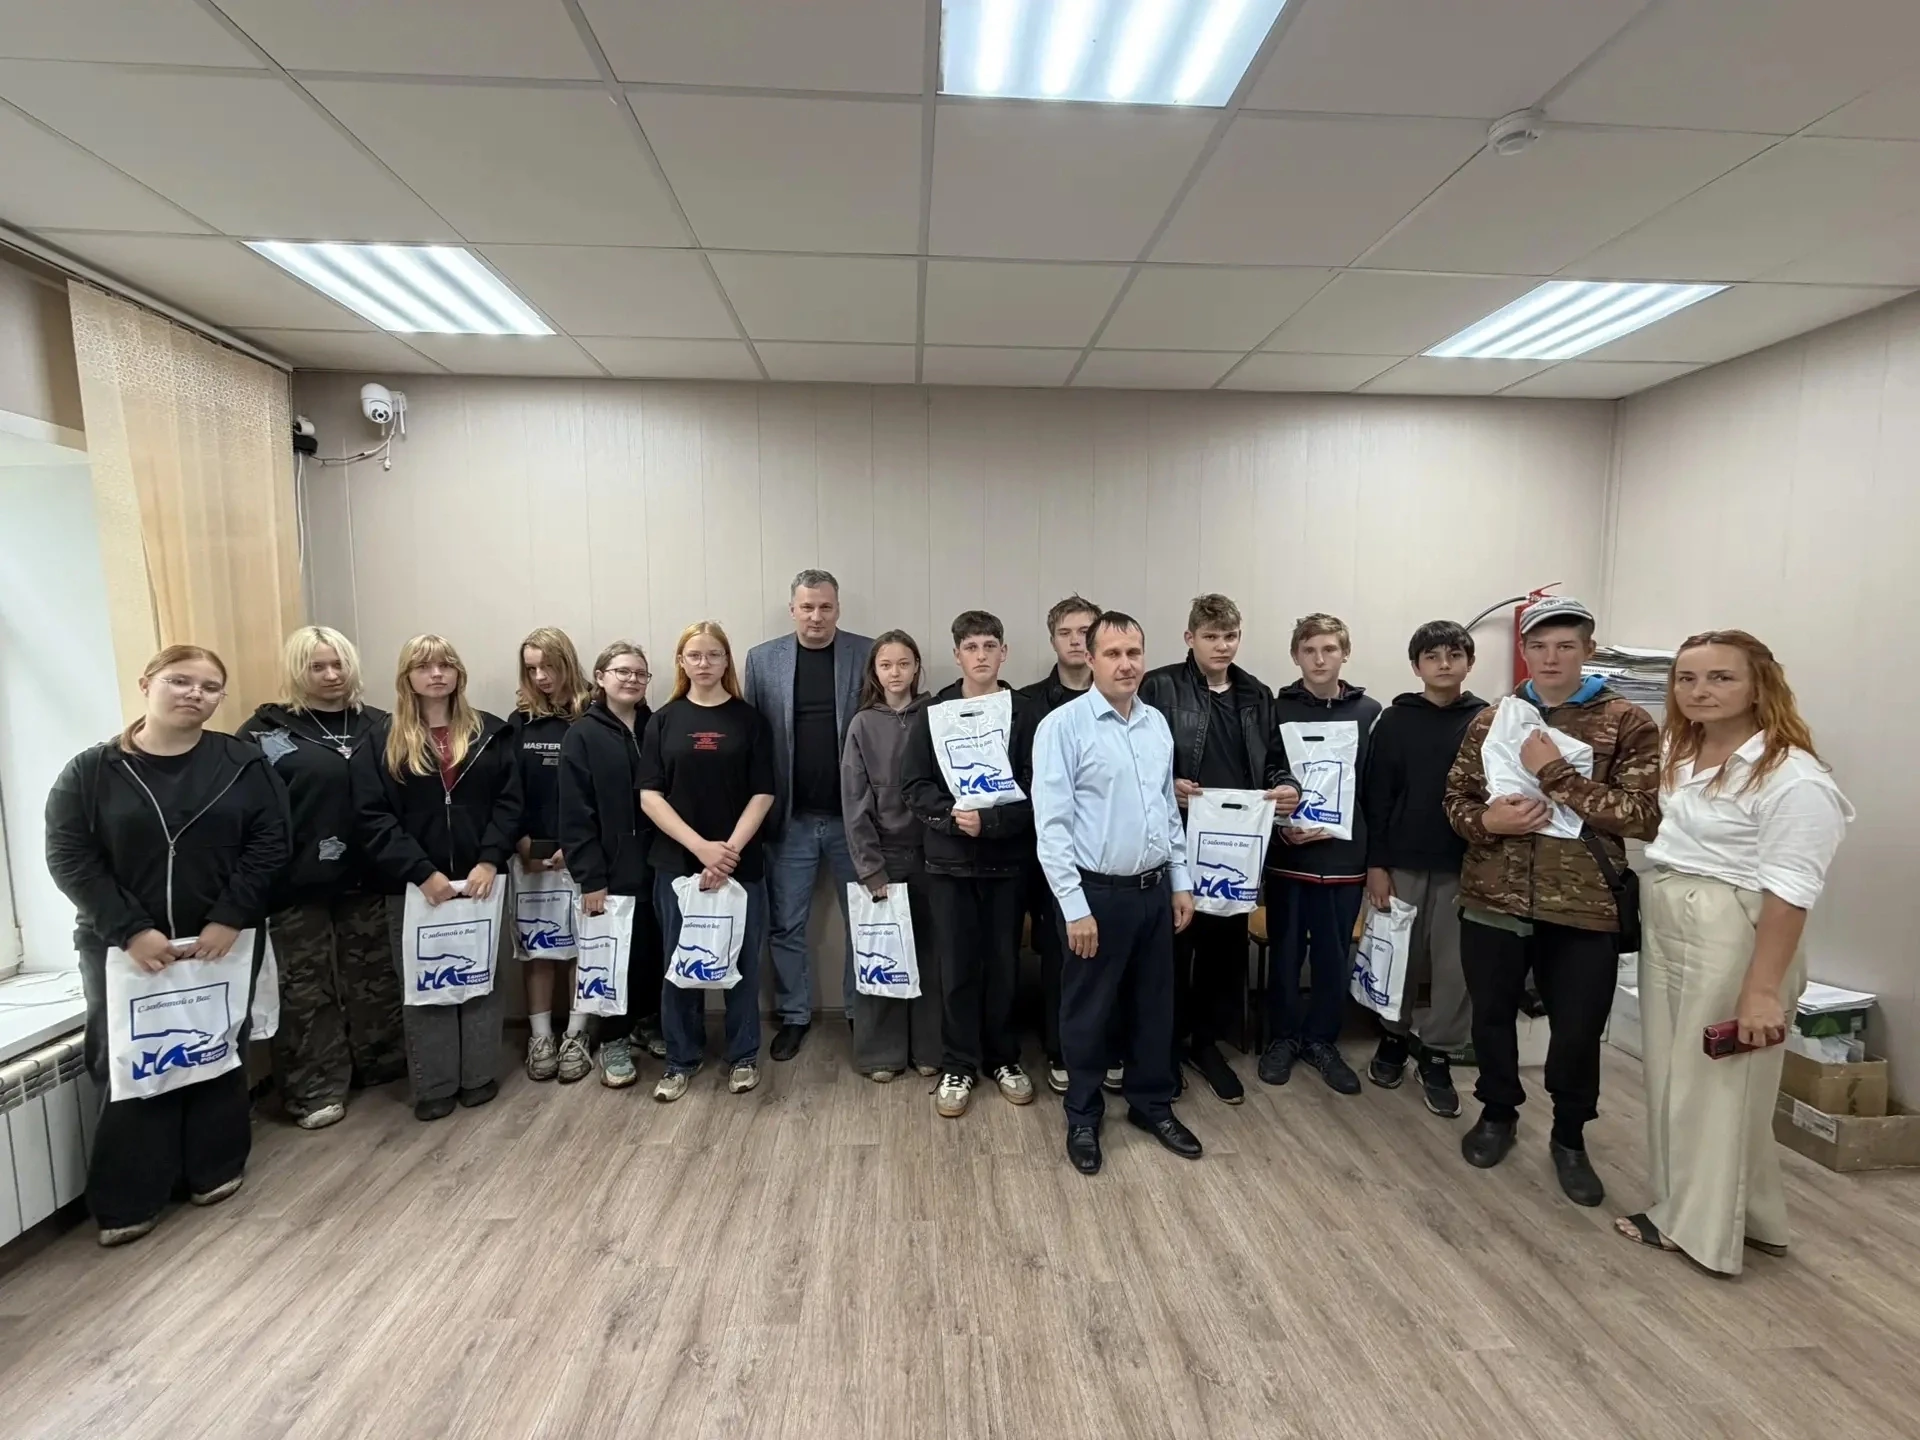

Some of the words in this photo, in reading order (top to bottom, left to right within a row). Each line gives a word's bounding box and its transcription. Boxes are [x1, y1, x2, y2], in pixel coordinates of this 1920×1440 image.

[523, 742, 561, 750] MASTER
[1207, 839, 1233, 847] заботой
[422, 932, 429, 940] С
[428, 929, 458, 939] заботой
[144, 998, 188, 1012] заботой
[195, 995, 212, 1003] Вас
